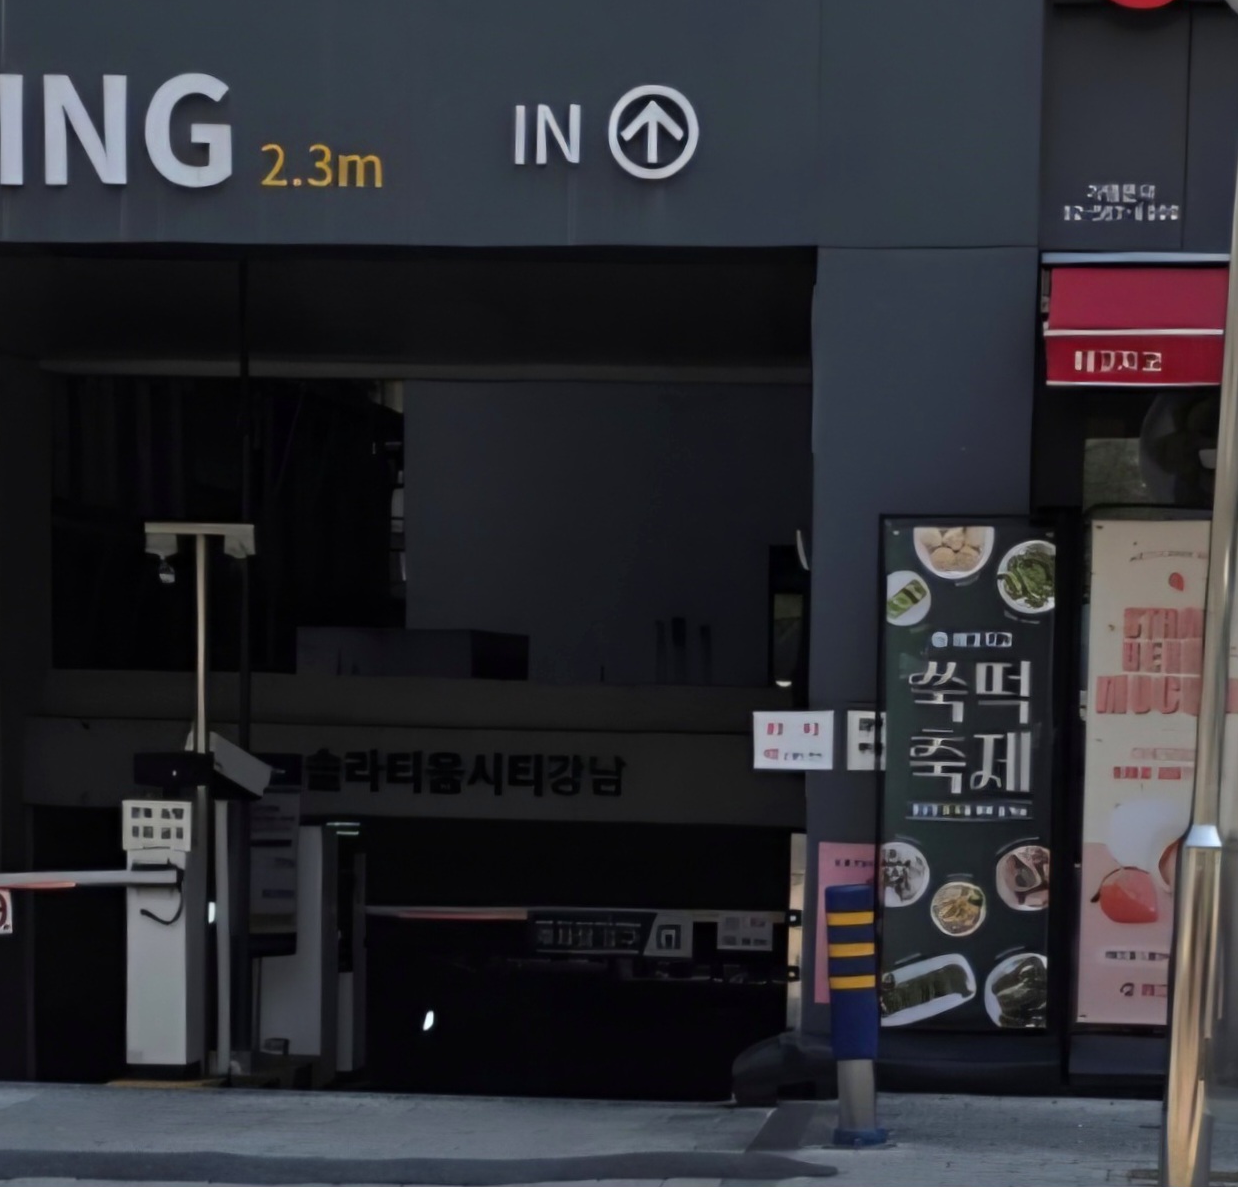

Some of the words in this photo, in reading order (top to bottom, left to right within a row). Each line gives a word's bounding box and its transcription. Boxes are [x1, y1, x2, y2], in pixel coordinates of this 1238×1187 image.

[260, 143, 383, 189] 2.3m
[514, 103, 581, 166] IN
[908, 660, 1032, 724] 쑥떡
[908, 728, 1032, 794] 축제
